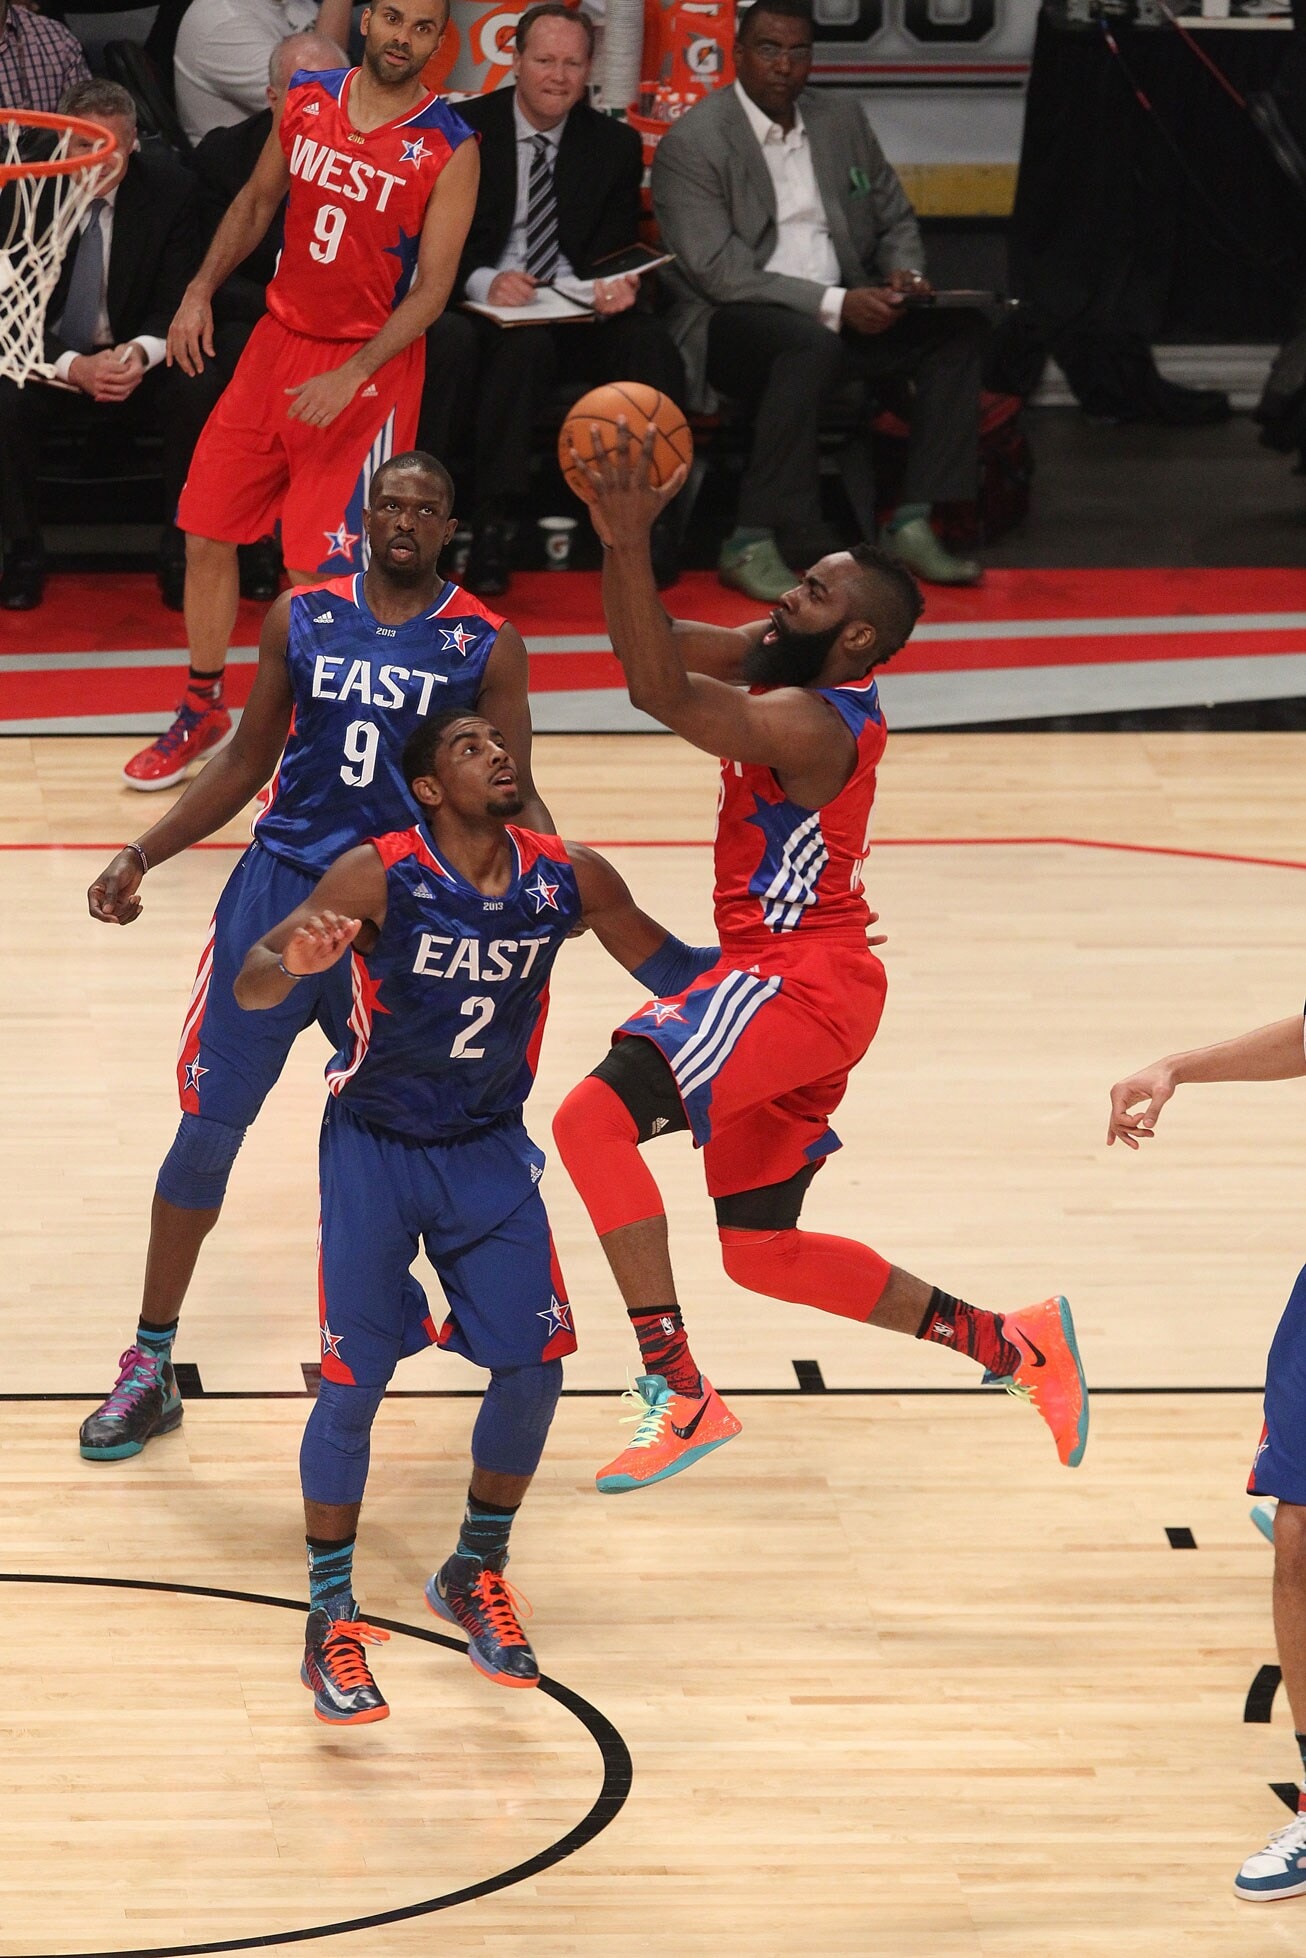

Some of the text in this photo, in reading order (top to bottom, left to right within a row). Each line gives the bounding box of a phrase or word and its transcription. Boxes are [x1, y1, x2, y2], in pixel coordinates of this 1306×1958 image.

[686, 38, 718, 74] G
[289, 134, 407, 213] WEST
[309, 204, 347, 264] 9
[375, 627, 397, 638] 2013
[311, 655, 449, 717] EAST
[339, 719, 380, 788] 9
[482, 901, 504, 911] 2013
[412, 933, 550, 982] EAST
[449, 995, 496, 1059] 2
